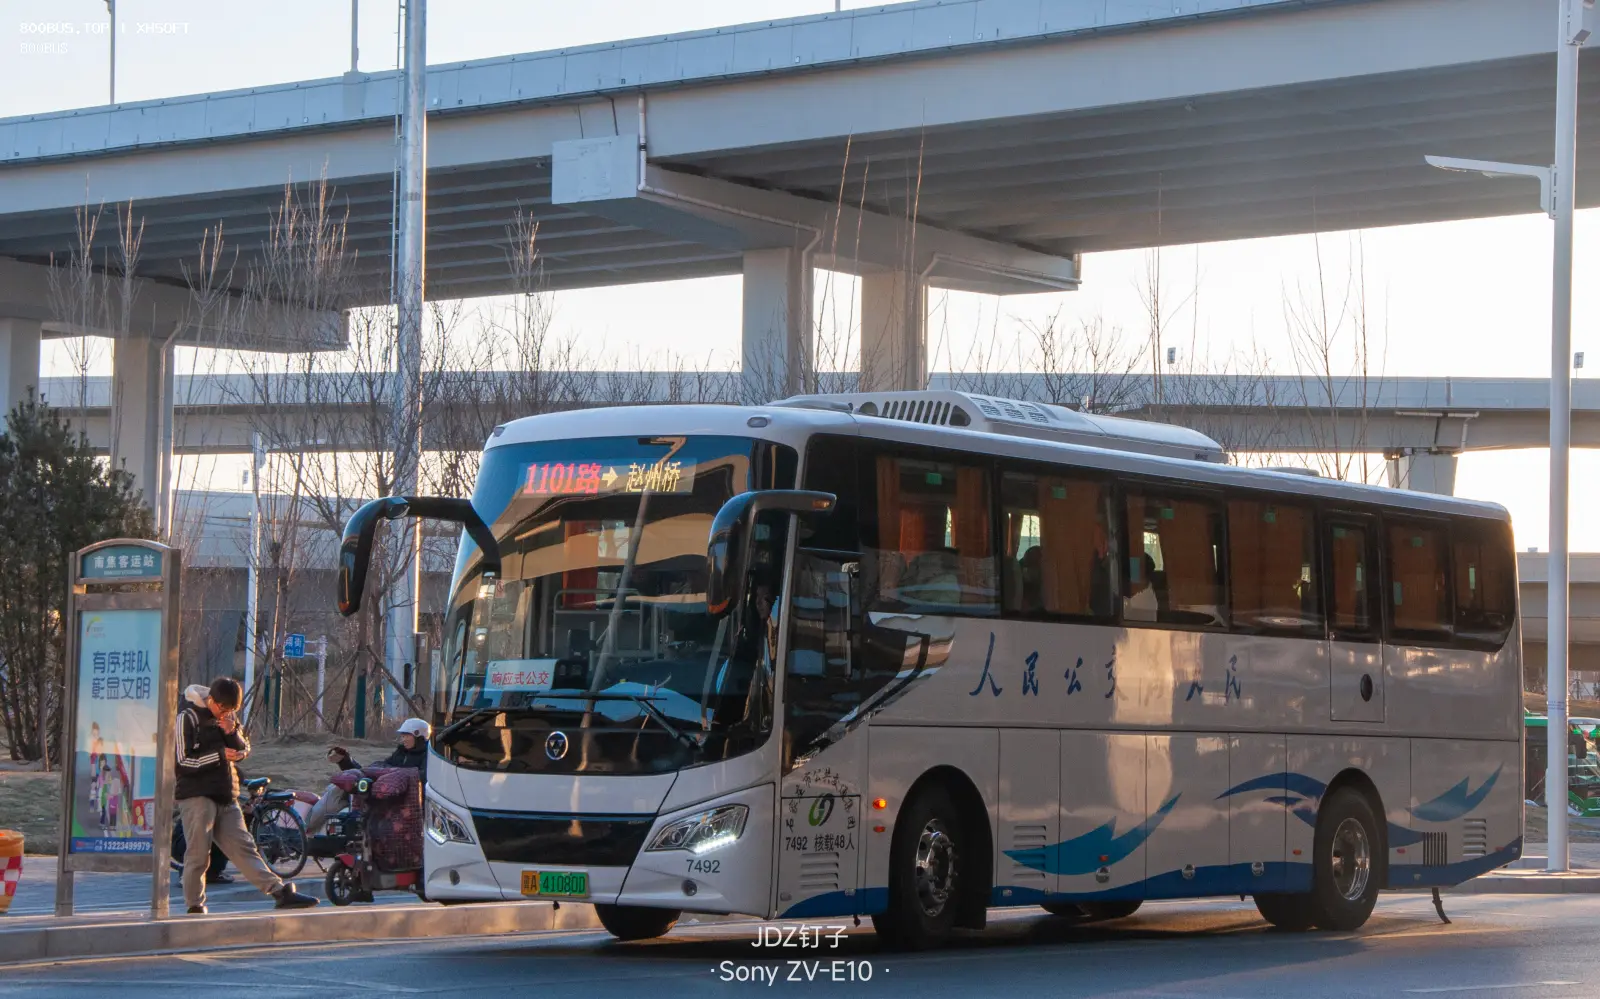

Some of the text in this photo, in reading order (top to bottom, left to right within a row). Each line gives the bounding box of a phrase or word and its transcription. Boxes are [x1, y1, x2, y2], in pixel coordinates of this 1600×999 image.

[523, 461, 682, 494] 1101路 赵州桥
[94, 553, 155, 569] 南焦客运站
[92, 650, 152, 674] 有序排队
[91, 676, 151, 700] 彰显文明
[491, 671, 550, 686] 响应式公交
[785, 832, 855, 852] 7492 核载48人
[686, 859, 720, 874] 7492
